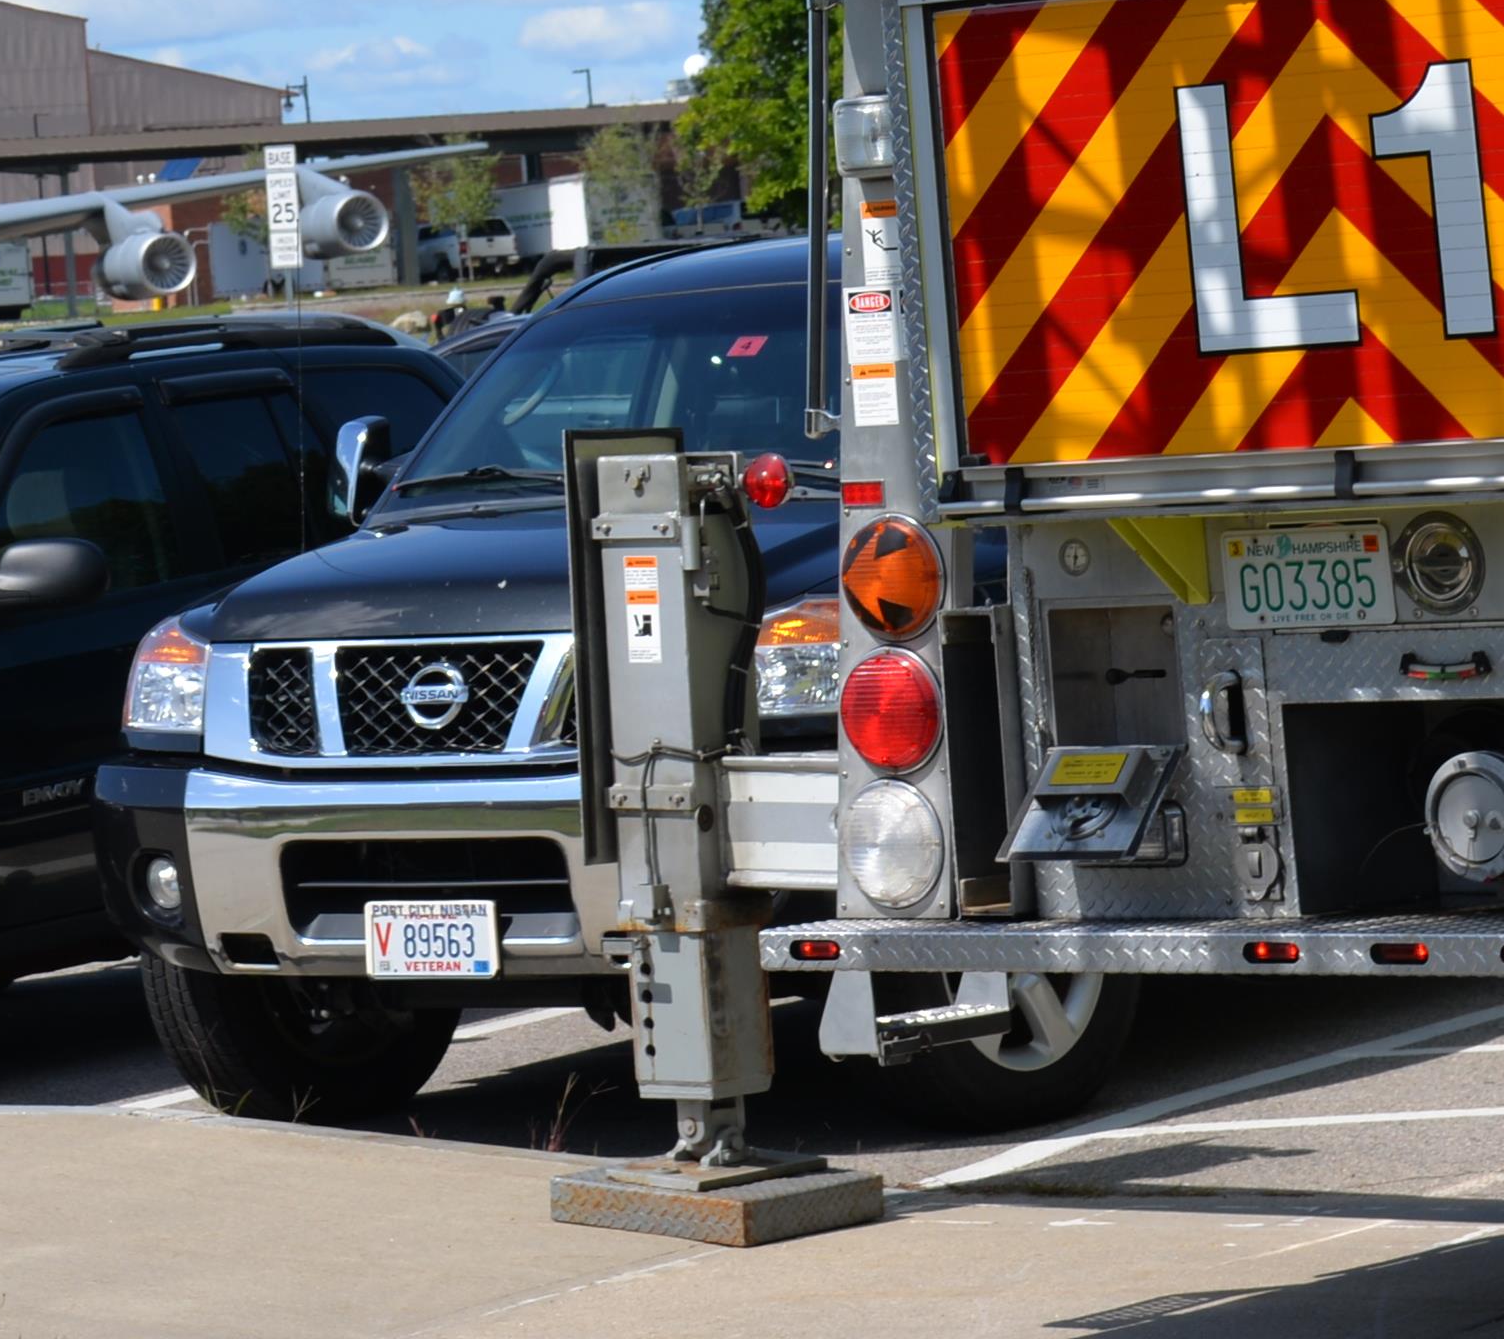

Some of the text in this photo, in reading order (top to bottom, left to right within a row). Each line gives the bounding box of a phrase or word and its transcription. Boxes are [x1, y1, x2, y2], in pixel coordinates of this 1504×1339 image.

[268, 151, 291, 165] BASE
[272, 202, 296, 224] 25
[1174, 59, 1497, 356] L1
[855, 295, 885, 309] DANGER
[1247, 544, 1275, 557] NEW
[1292, 539, 1362, 555] HAMPSHIRE
[1240, 557, 1377, 613] G03385
[1295, 613, 1316, 622] FREE
[1320, 613, 1332, 621] OR
[1336, 612, 1350, 620] DIE
[402, 689, 459, 701] NISSAN
[372, 905, 403, 917] PORT
[408, 905, 435, 916] CITY
[440, 904, 487, 917] NISSAN
[374, 922, 476, 959] V 89563
[404, 961, 461, 972] VETERAN
